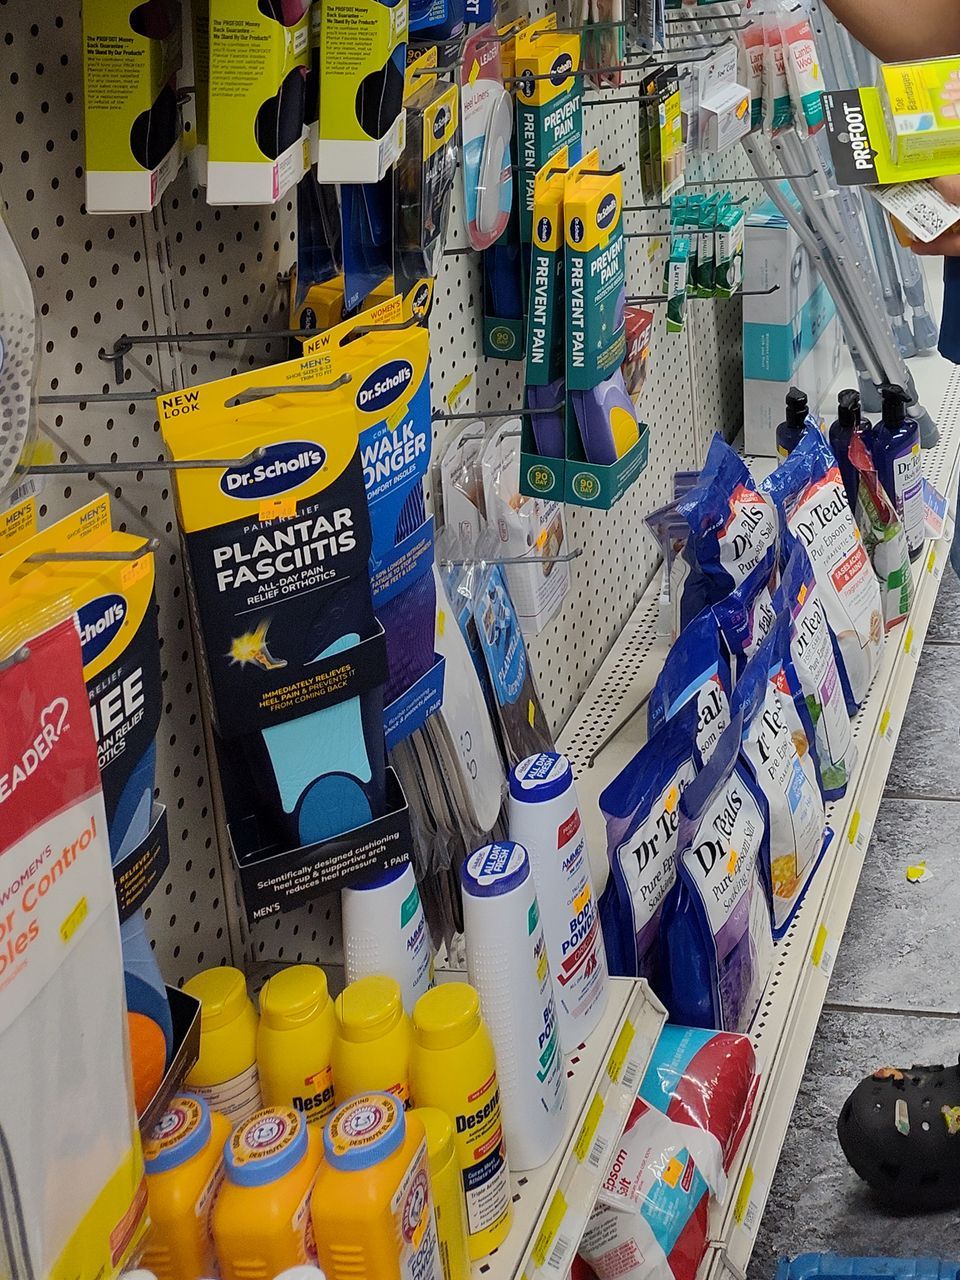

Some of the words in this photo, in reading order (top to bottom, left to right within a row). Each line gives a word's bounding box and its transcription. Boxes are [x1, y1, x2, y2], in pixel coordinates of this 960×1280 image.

[480, 47, 498, 66] LEADER
[796, 57, 813, 71] Wool
[901, 71, 918, 113] Bandages
[544, 95, 580, 133] PREVENT
[554, 116, 574, 142] PAIN
[843, 103, 874, 170] PROFOOT
[590, 234, 624, 278] PREVENT
[600, 259, 619, 286] PAIN
[534, 256, 550, 326] PREVENT
[570, 257, 584, 329] PREVENT
[369, 301, 402, 321] WOMEN'S
[307, 334, 331, 354] NEW
[531, 327, 546, 364] PAIN
[571, 330, 585, 368] PAIN
[629, 322, 652, 361] ACE
[300, 356, 331, 370] MEN'S
[163, 390, 200, 410] NEW
[164, 402, 200, 420] LOOK
[360, 419, 415, 469] WALK
[362, 432, 426, 491] ONGER
[367, 478, 393, 500] OMFORT
[393, 463, 417, 485] INSOLES
[535, 471, 548, 481] 90
[580, 486, 593, 494] DAY
[5, 502, 32, 527] MEN'S
[79, 502, 107, 526] MEN'S
[243, 519, 273, 535] PAIN
[797, 521, 819, 548] Dr
[809, 485, 849, 530] Teal's
[213, 507, 354, 569] PLANTAR
[822, 522, 848, 549] Epsom
[216, 530, 357, 593] FASCIITIS
[257, 572, 300, 594] ALL-DAY
[300, 564, 325, 578] PAIN
[738, 555, 759, 576] Pure
[247, 588, 280, 606] RELIEF
[281, 569, 337, 595] ORTHOTICS
[89, 667, 123, 700] RELIEF
[259, 696, 280, 709] HEEL
[281, 689, 301, 701] PAIN
[308, 672, 348, 692] PREVENTS
[348, 668, 357, 677] IT
[262, 677, 314, 700] IMMEDIATELY
[315, 663, 352, 682] RELIEVES
[270, 699, 294, 712] FROM
[294, 689, 326, 704] COMING
[327, 679, 348, 693] BACK
[116, 707, 145, 741] RELIEF
[0, 722, 58, 804] EADER
[536, 752, 550, 768] DAY
[536, 758, 555, 779] FRESH
[21, 815, 97, 912] Control
[119, 851, 150, 885] RELIEVES
[257, 865, 313, 890] Scientifically
[314, 849, 354, 871] designed
[355, 831, 400, 855] cushioning
[273, 880, 293, 893] heel
[294, 874, 311, 887] cup
[312, 870, 319, 878] &
[320, 854, 367, 878] supportive
[368, 844, 387, 857] arch
[390, 852, 410, 866] PAIR
[491, 843, 503, 862] DAY
[494, 848, 511, 874] FRESH
[632, 836, 659, 878] Dr
[692, 838, 727, 878] Dr
[0, 843, 53, 907] WOMEN'S
[285, 879, 320, 897] reduces
[321, 871, 340, 883] heel
[341, 856, 378, 878] pressure
[639, 867, 662, 902] Pure
[711, 870, 733, 903] Pure
[253, 902, 281, 920] MEN'S
[723, 873, 749, 915] Soaking
[561, 906, 598, 956] POWDER
[569, 897, 592, 932] BODY
[602, 1148, 628, 1193] Epsom
[616, 1178, 629, 1197] Salt
